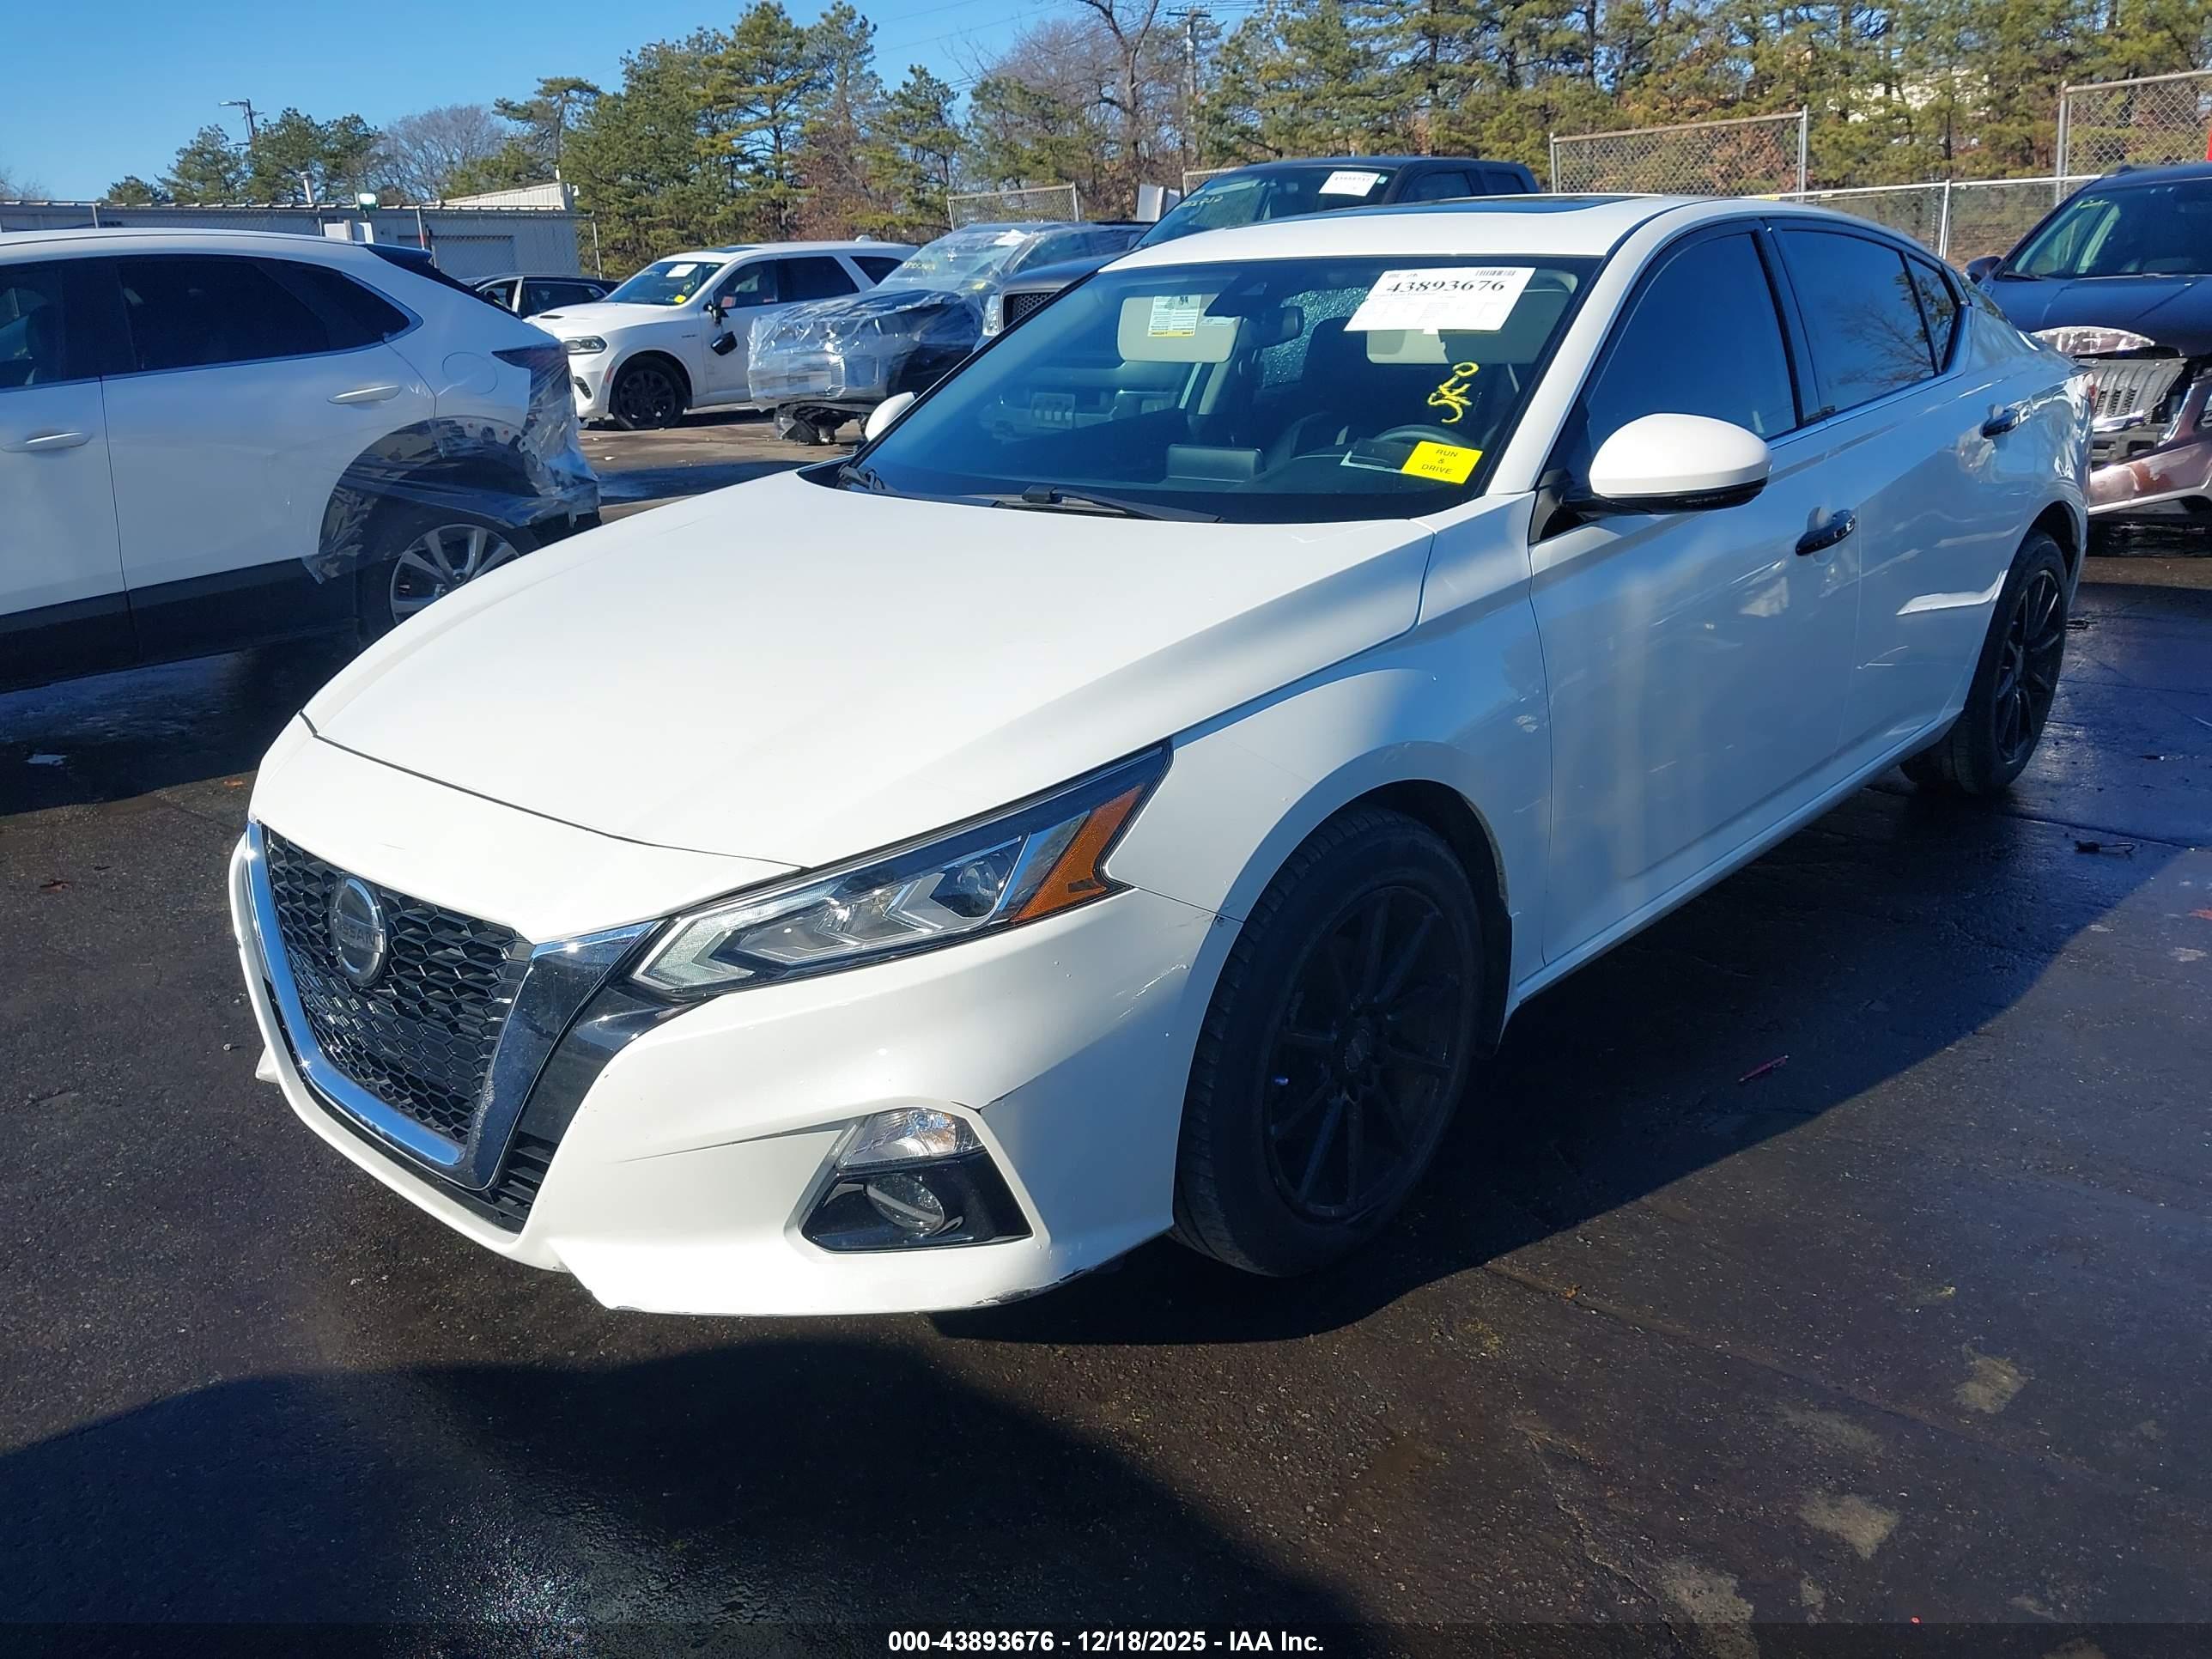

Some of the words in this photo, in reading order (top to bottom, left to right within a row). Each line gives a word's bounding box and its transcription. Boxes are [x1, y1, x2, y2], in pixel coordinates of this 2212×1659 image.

[1385, 280, 1505, 293] 43893676
[1435, 448, 1459, 458] RUN
[1421, 464, 1454, 475] DRIVE
